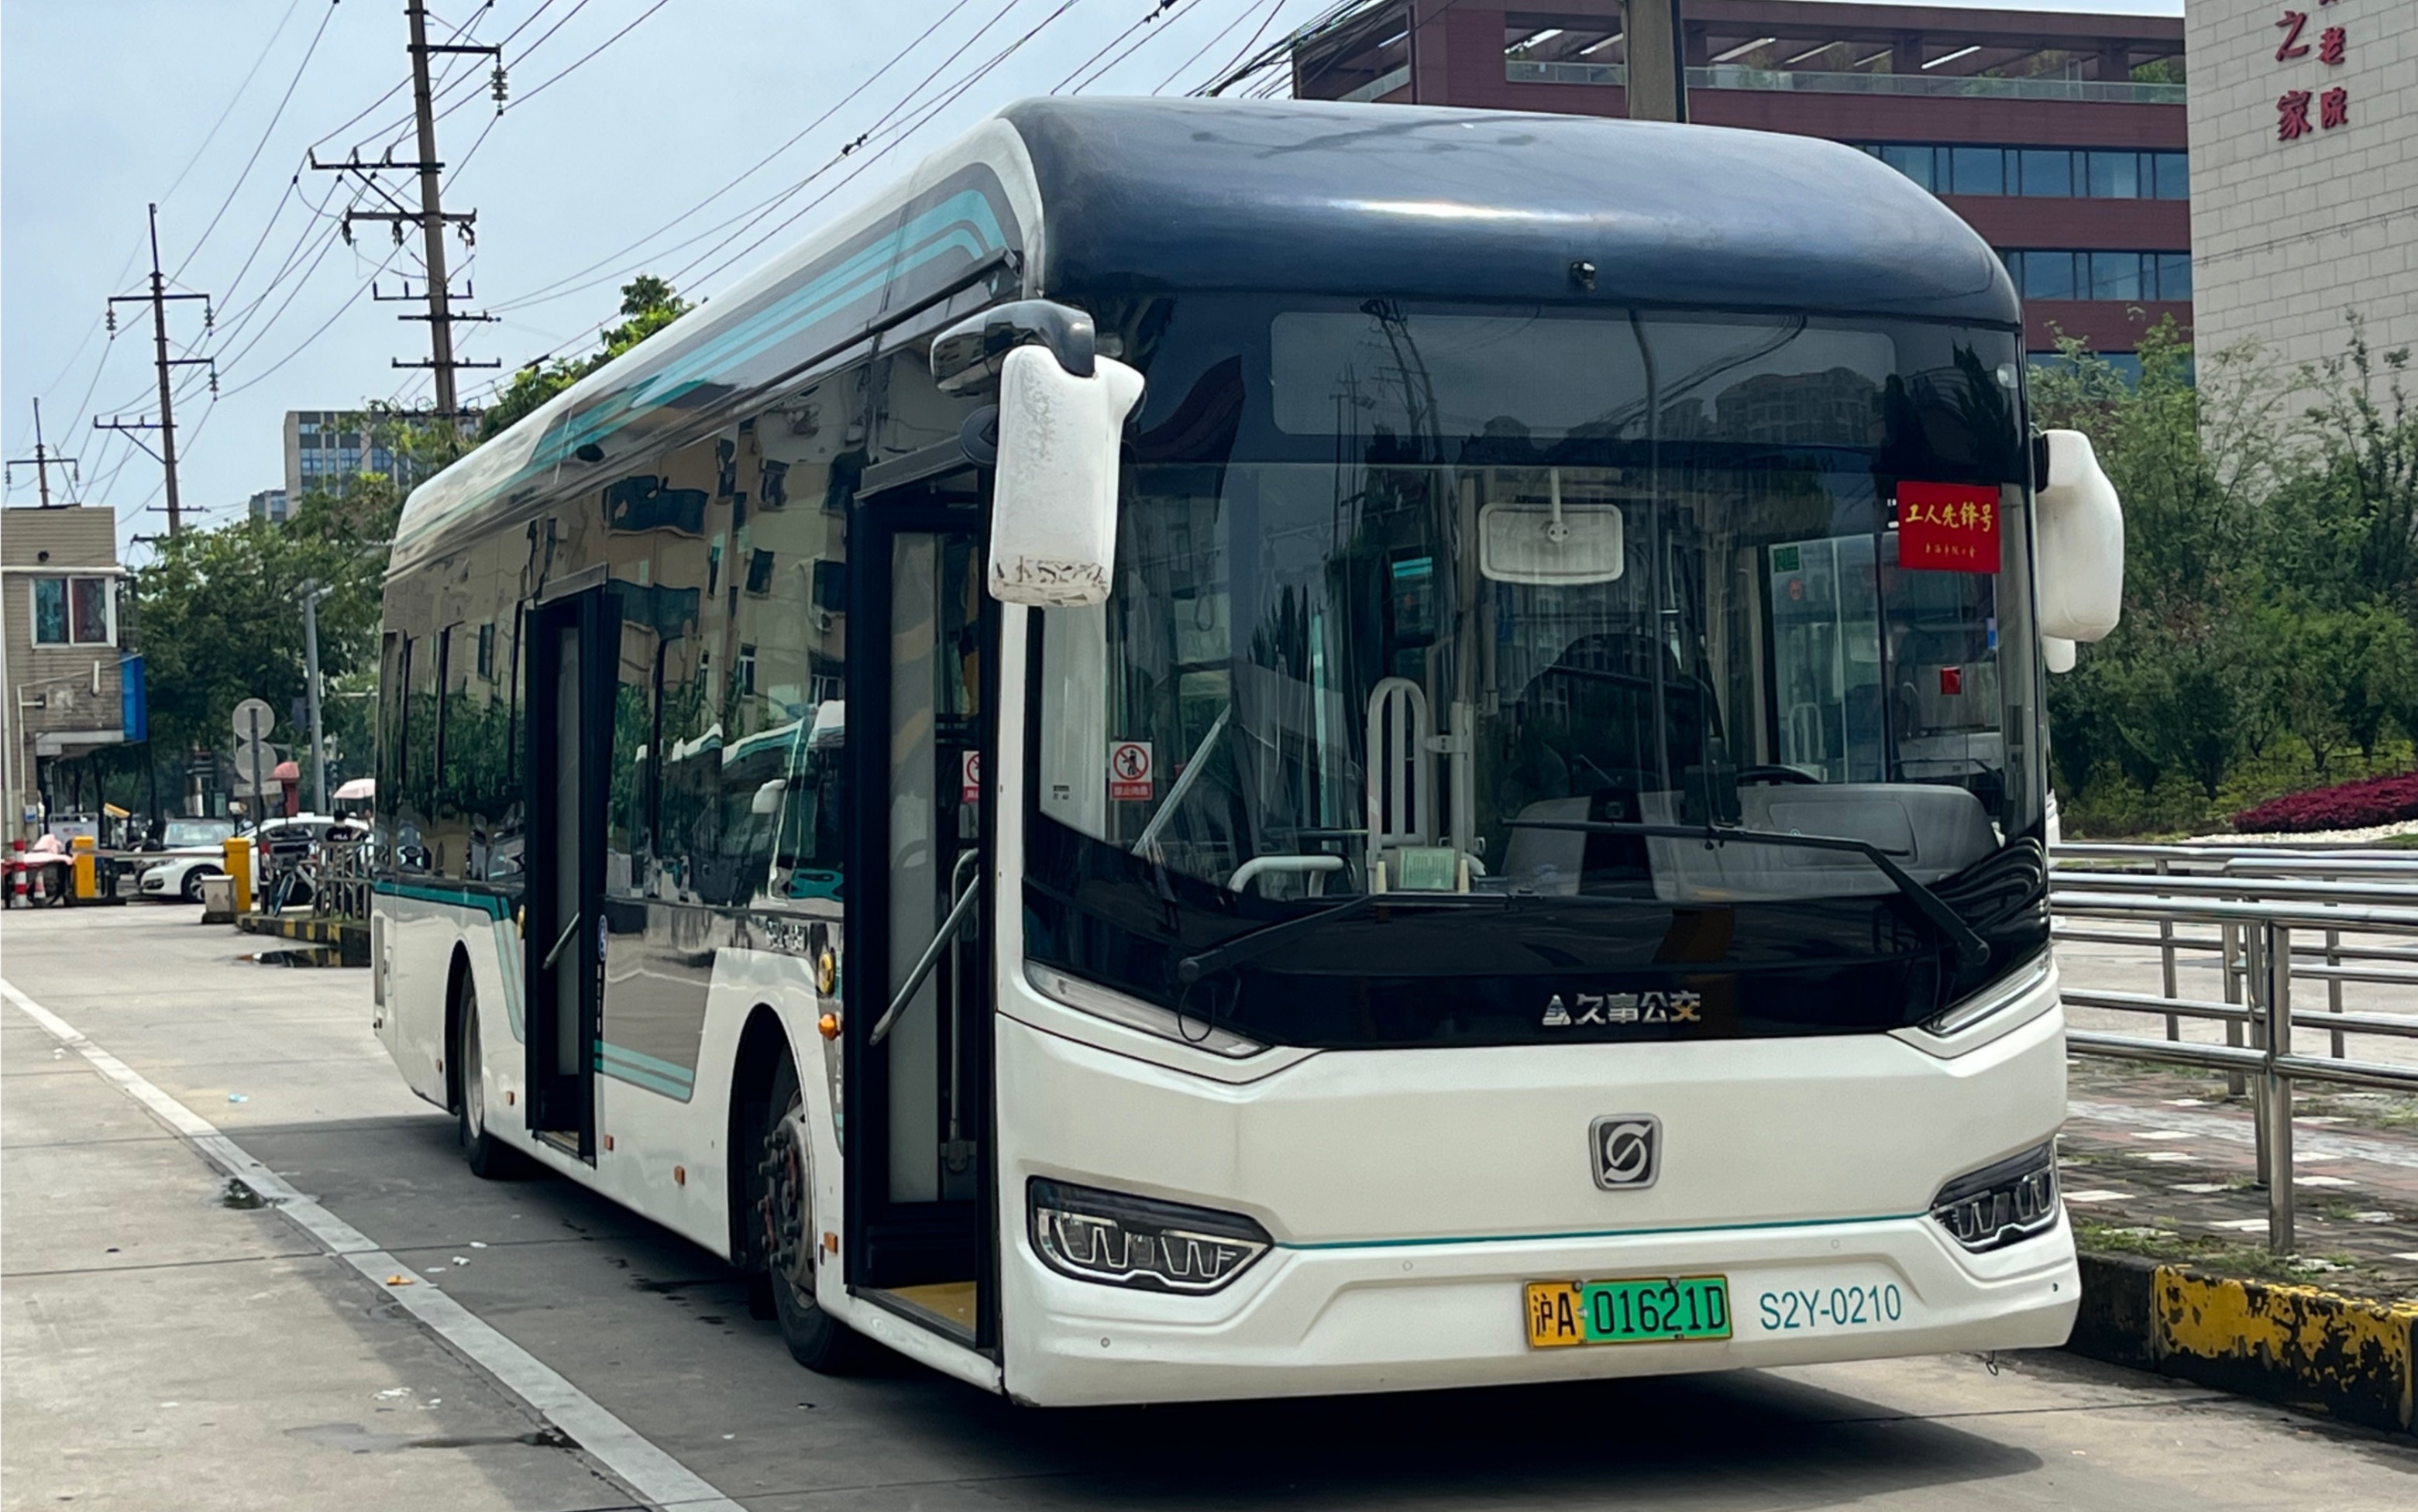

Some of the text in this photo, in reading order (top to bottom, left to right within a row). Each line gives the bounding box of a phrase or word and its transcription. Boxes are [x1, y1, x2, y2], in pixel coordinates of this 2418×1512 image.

[2275, 10, 2313, 141] 之家
[2318, 0, 2348, 130] 老院
[1905, 501, 1993, 532] 工人先锋号
[1574, 990, 1701, 1026] 久事公交
[1759, 1283, 1902, 1331] S2Y-0210
